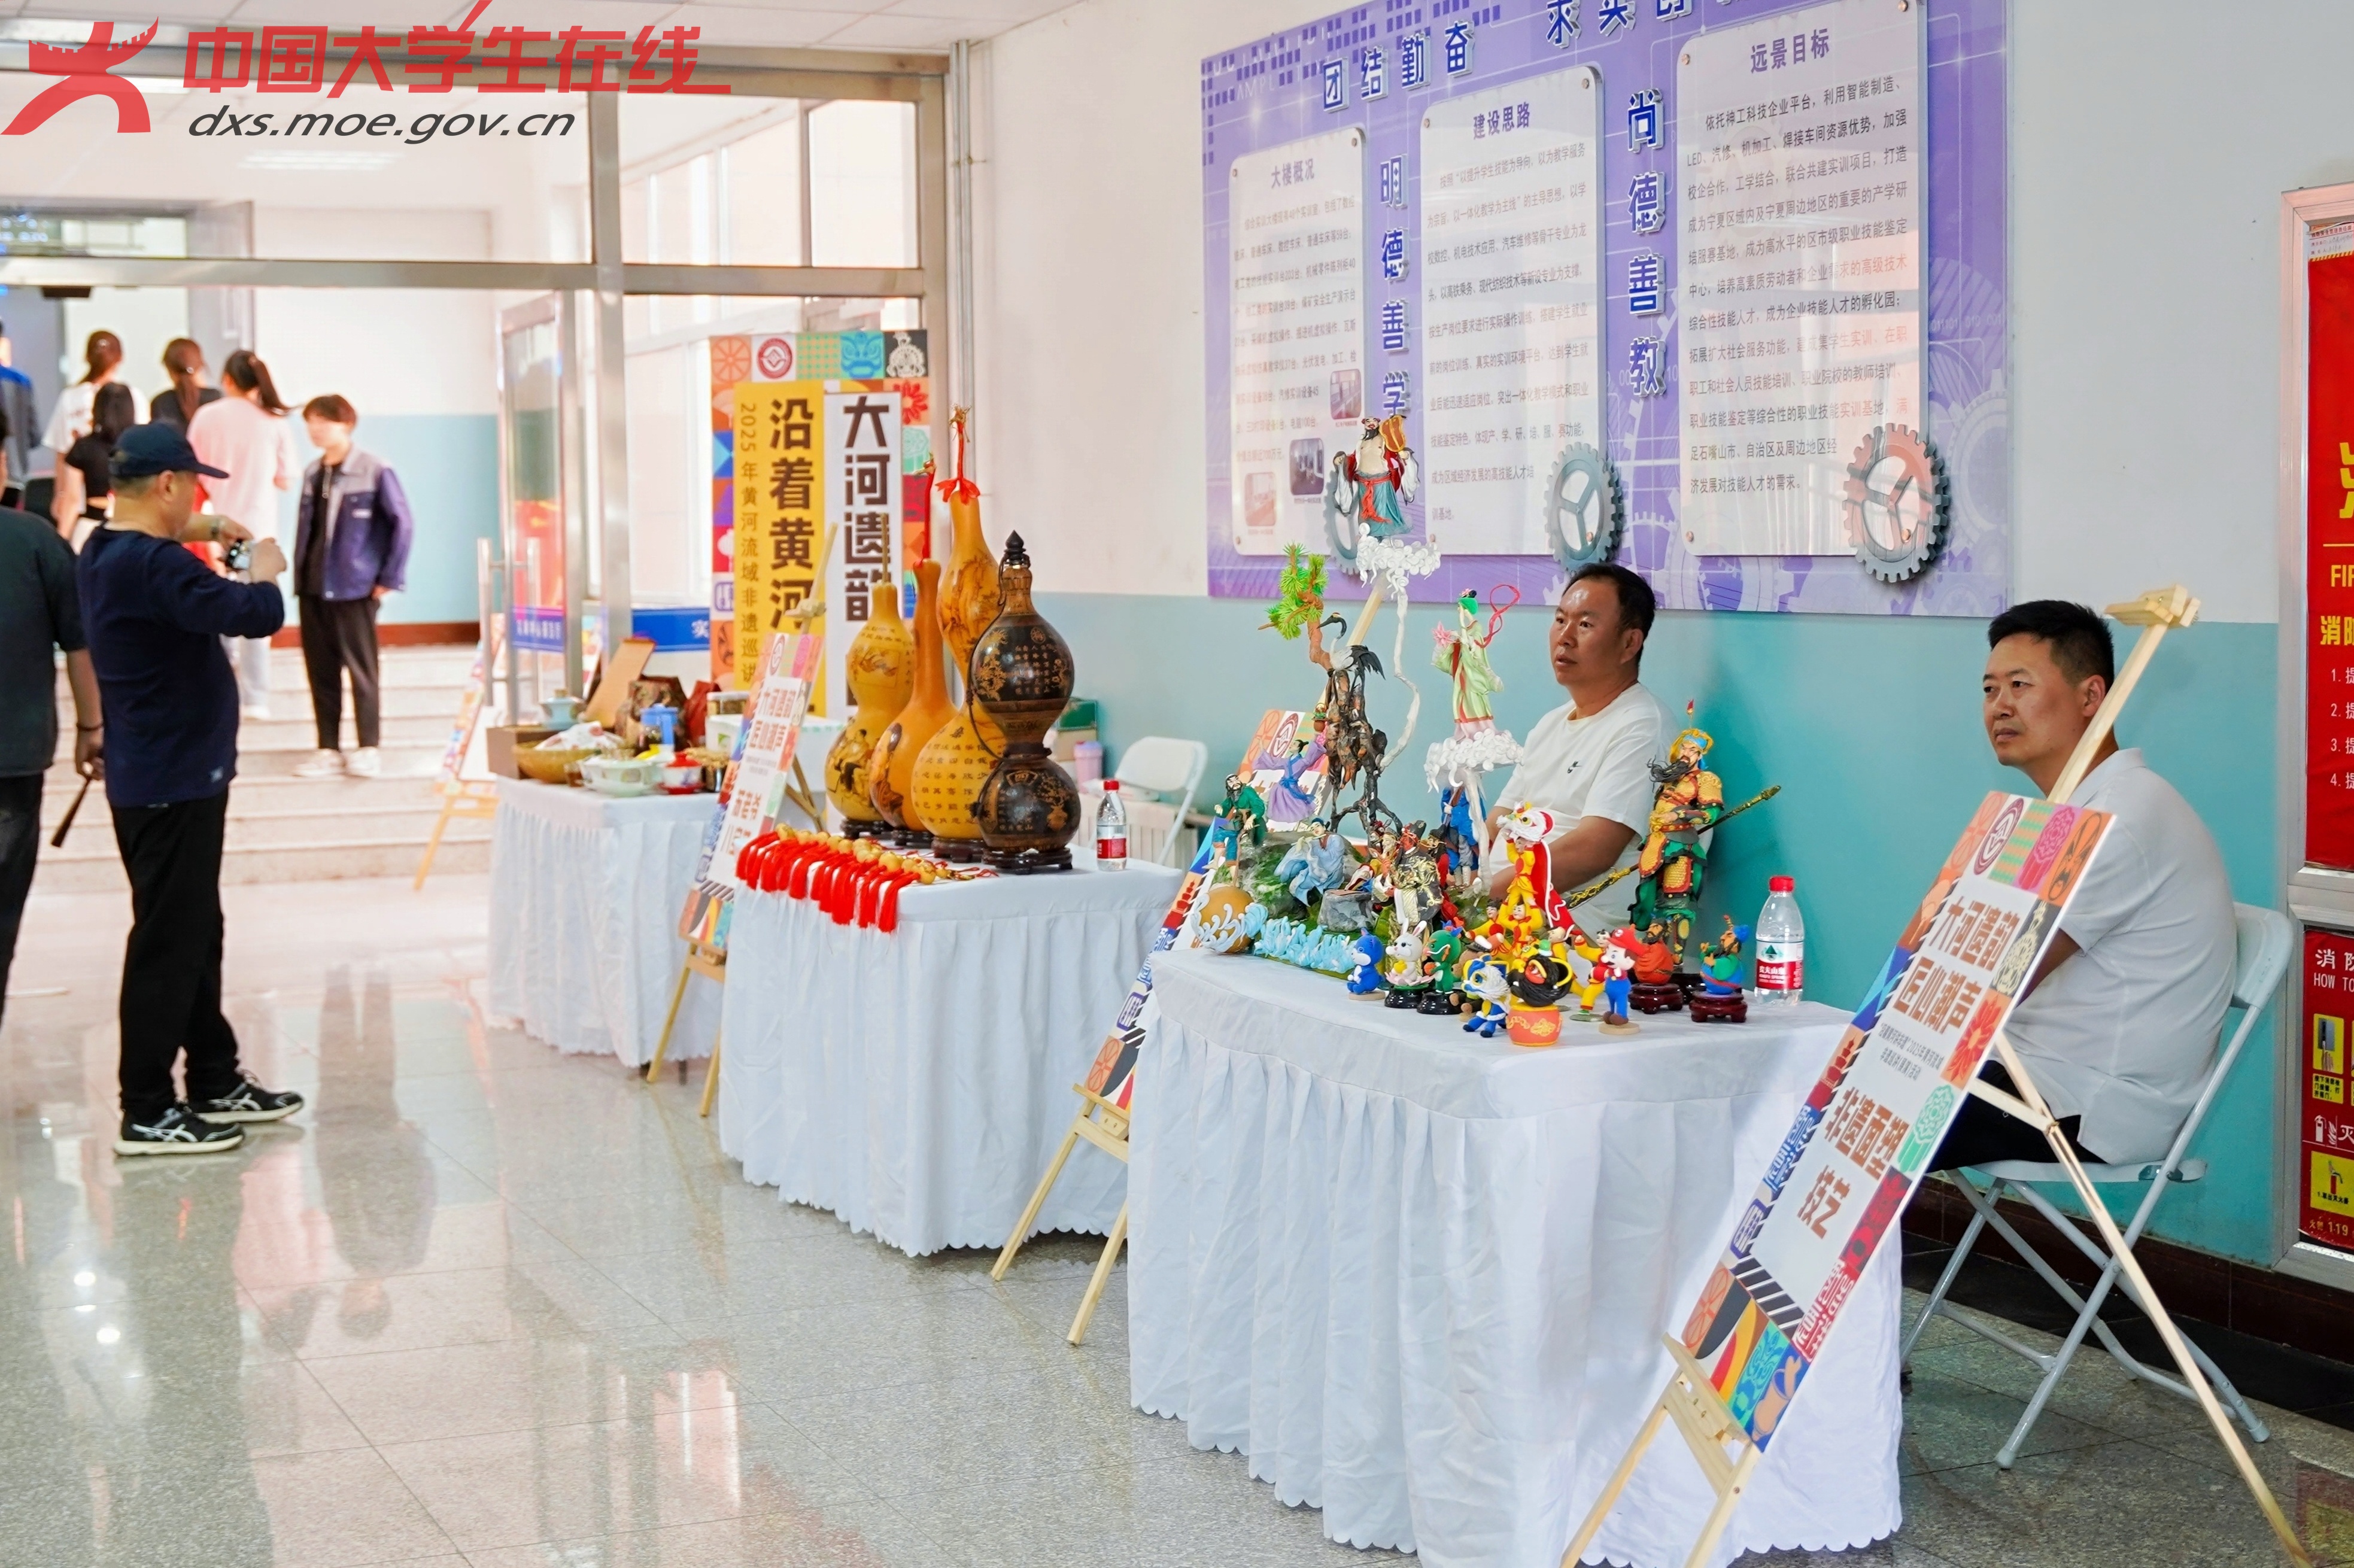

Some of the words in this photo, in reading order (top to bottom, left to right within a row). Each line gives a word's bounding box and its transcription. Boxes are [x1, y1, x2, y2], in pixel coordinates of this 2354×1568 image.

[1323, 20, 1474, 112] 团结勤奋
[1749, 28, 1830, 74] 远景目标
[1473, 101, 1530, 141] 建设思路
[1271, 158, 1315, 189] 大楼概况
[1627, 89, 1666, 397] 尚德善教
[1380, 154, 1408, 417] 明德善学
[769, 397, 816, 633] 沿着黄河
[843, 396, 891, 622] 大河遗韵
[1928, 896, 2021, 972] 大河遗韵
[1893, 956, 1982, 1035] 匠心潮声
[2313, 972, 2335, 989] HOW
[2342, 977, 2354, 993] TO
[1824, 1087, 1910, 1181] 非遗面塑
[1797, 1165, 1851, 1239] 技艺
[2328, 1221, 2349, 1236] 119
